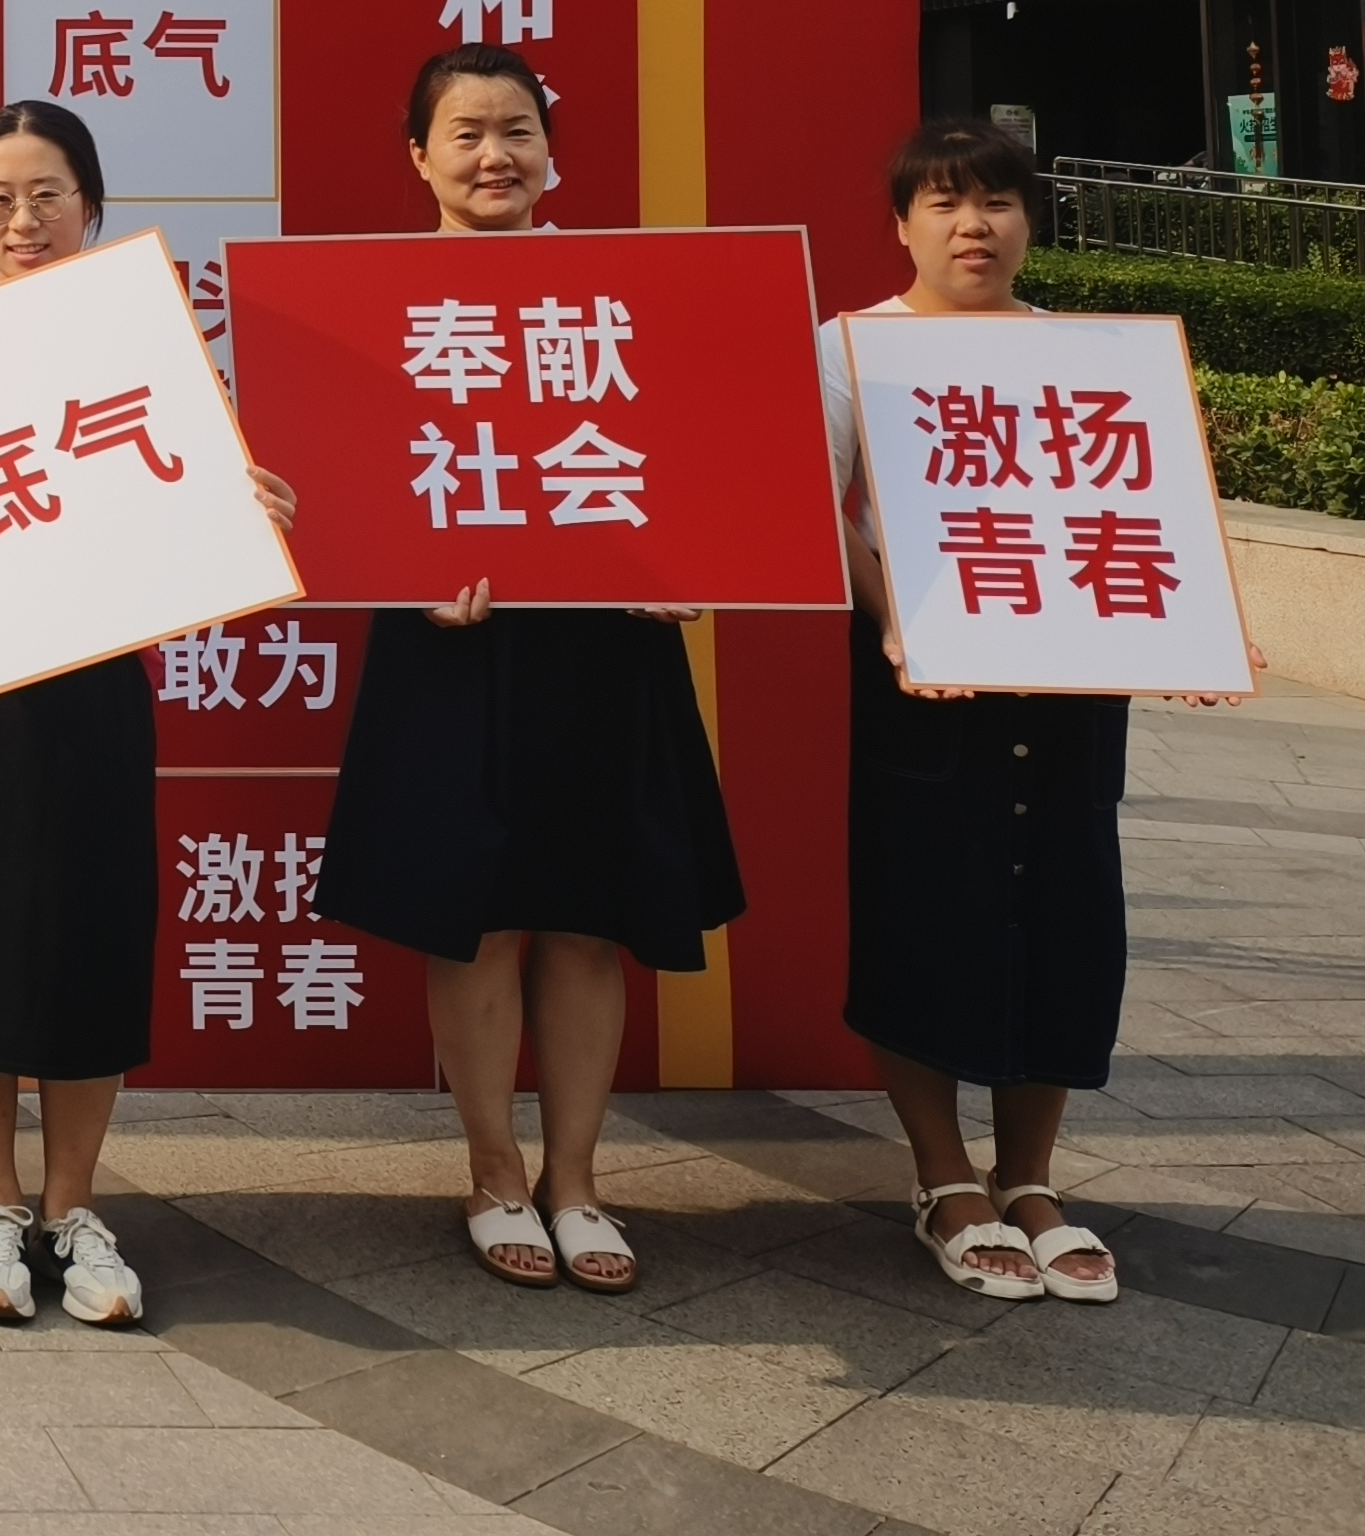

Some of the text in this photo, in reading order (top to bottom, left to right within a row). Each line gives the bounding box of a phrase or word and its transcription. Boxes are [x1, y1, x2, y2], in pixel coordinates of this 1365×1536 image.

[47, 10, 231, 99] 底气
[401, 295, 639, 405] 奉献
[409, 420, 649, 529] 社会
[911, 384, 1154, 492] 激扬
[937, 506, 1182, 619] 青春
[179, 938, 365, 1030] 青春
